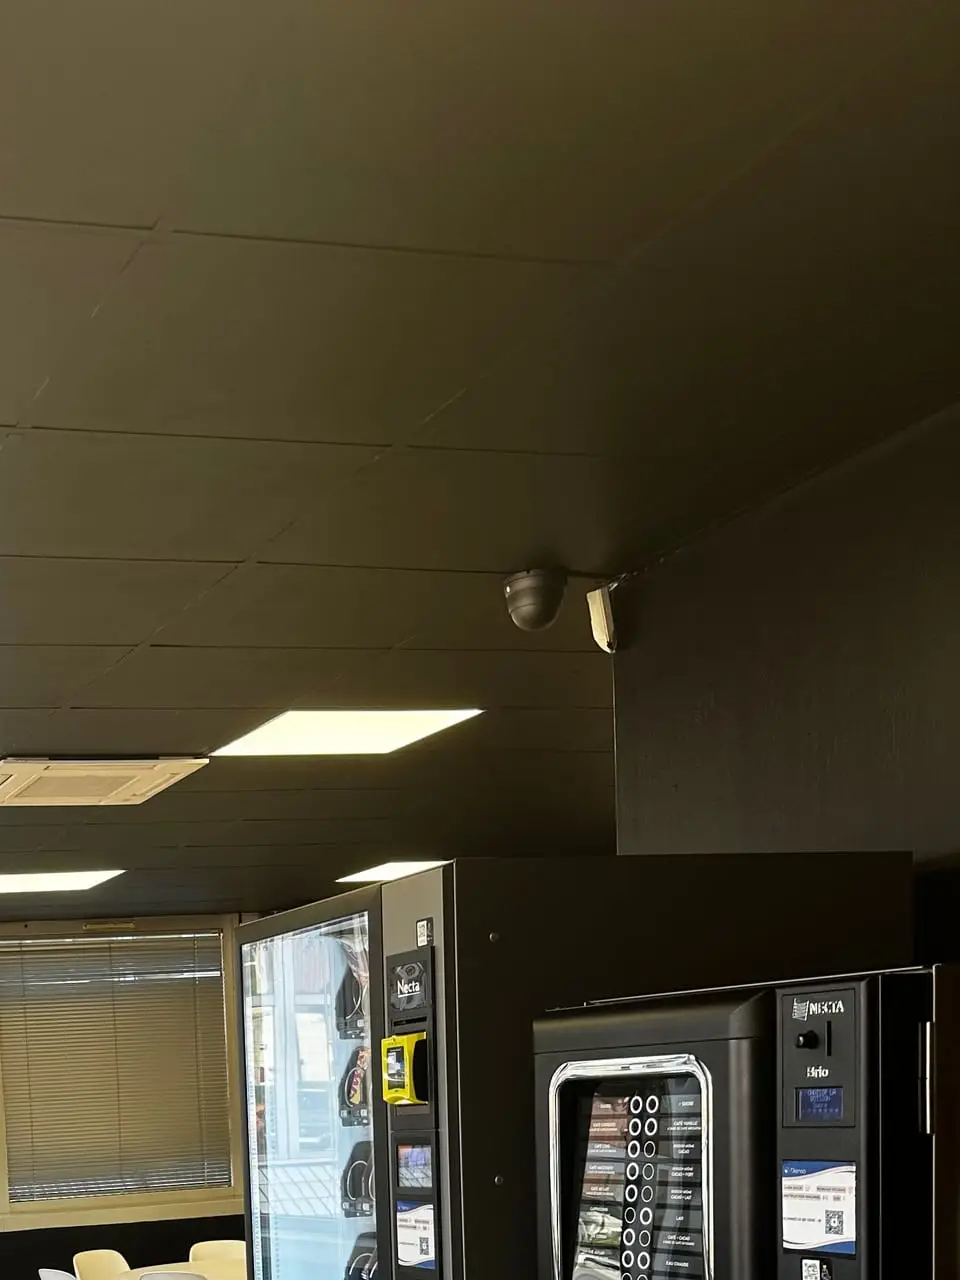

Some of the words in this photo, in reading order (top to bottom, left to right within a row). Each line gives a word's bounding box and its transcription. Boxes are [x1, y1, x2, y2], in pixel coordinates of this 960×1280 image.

[397, 979, 420, 995] Necta
[809, 1000, 844, 1015] NECTA
[807, 1066, 829, 1078] Brio
